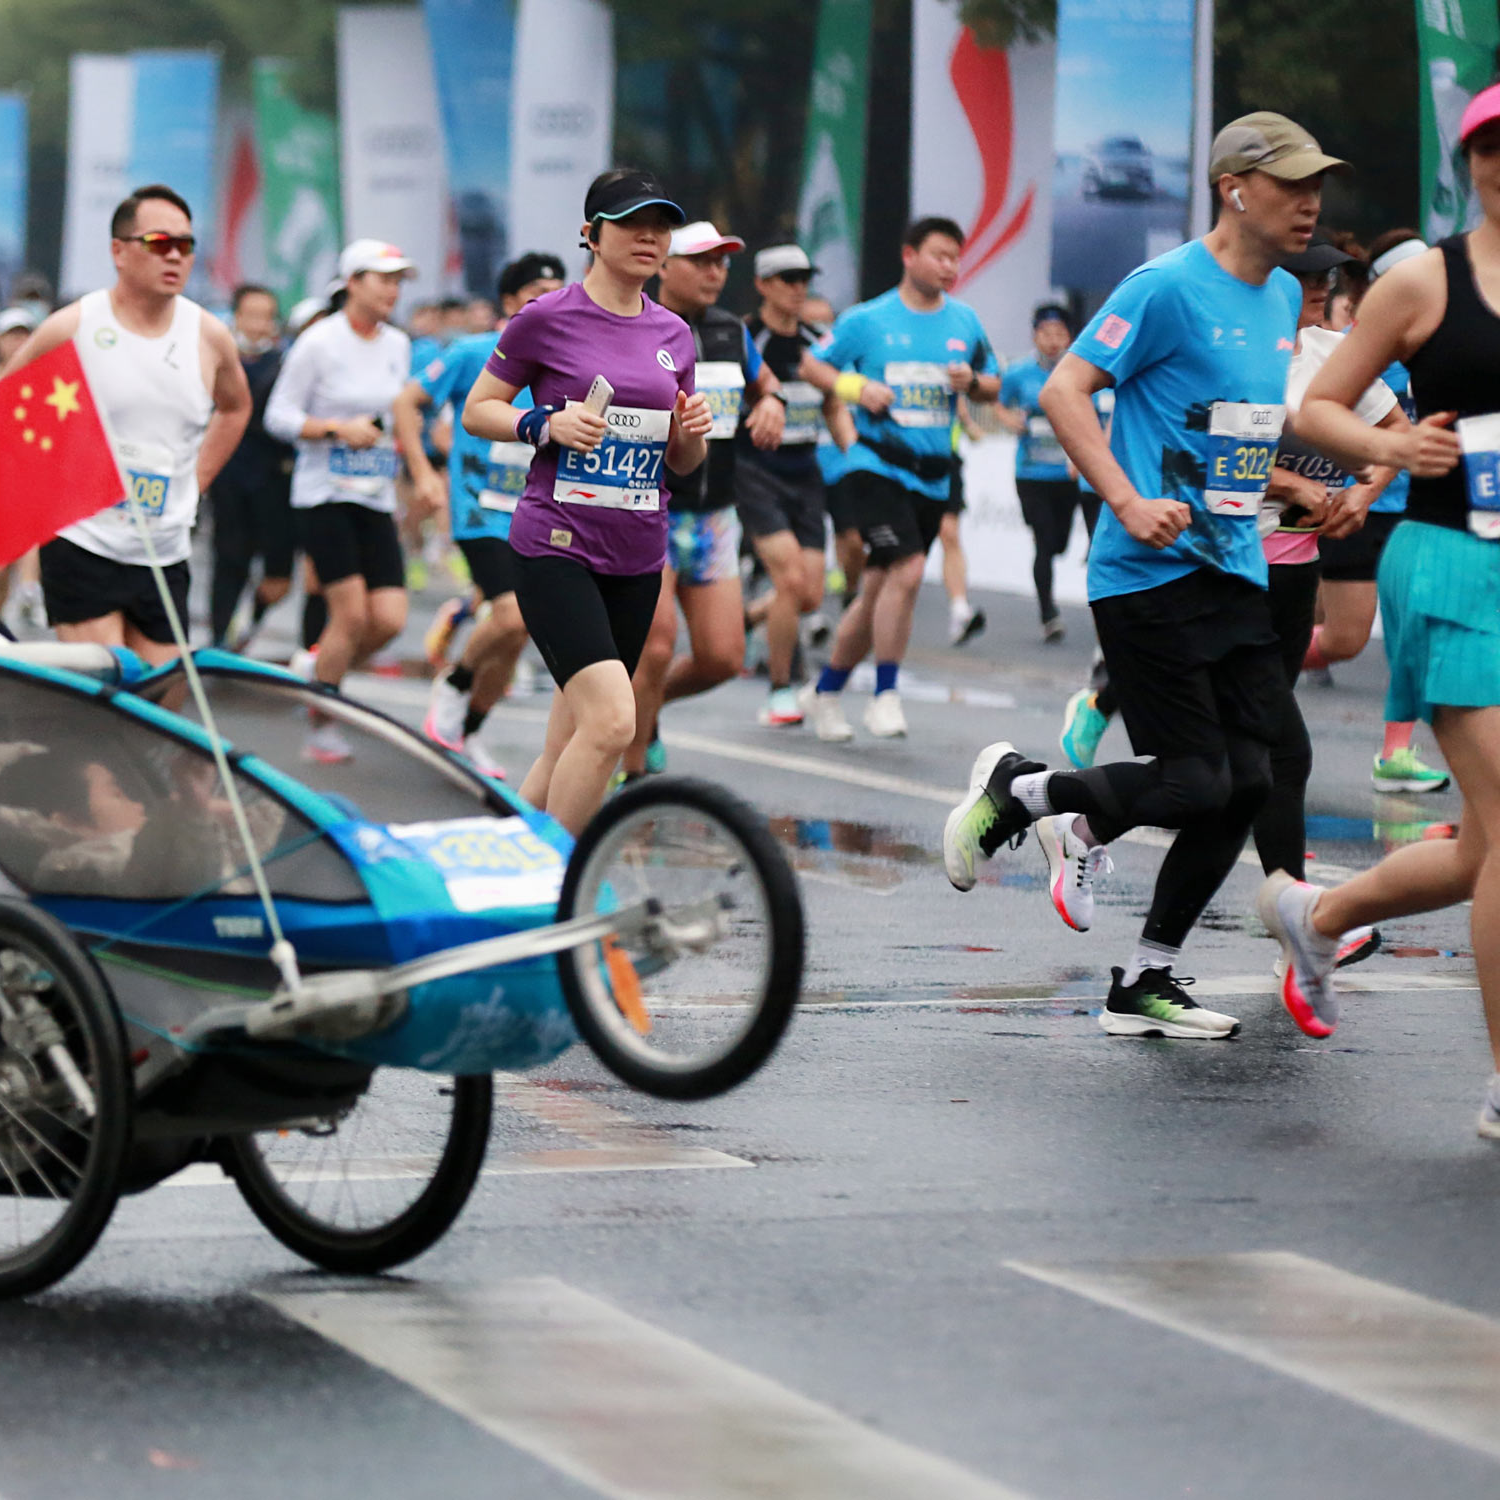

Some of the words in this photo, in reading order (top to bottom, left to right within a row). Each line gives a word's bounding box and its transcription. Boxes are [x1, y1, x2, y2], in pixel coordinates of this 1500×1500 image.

[566, 450, 578, 469] E
[583, 443, 664, 480] 51427
[1215, 456, 1228, 476] E
[1479, 473, 1496, 497] E
